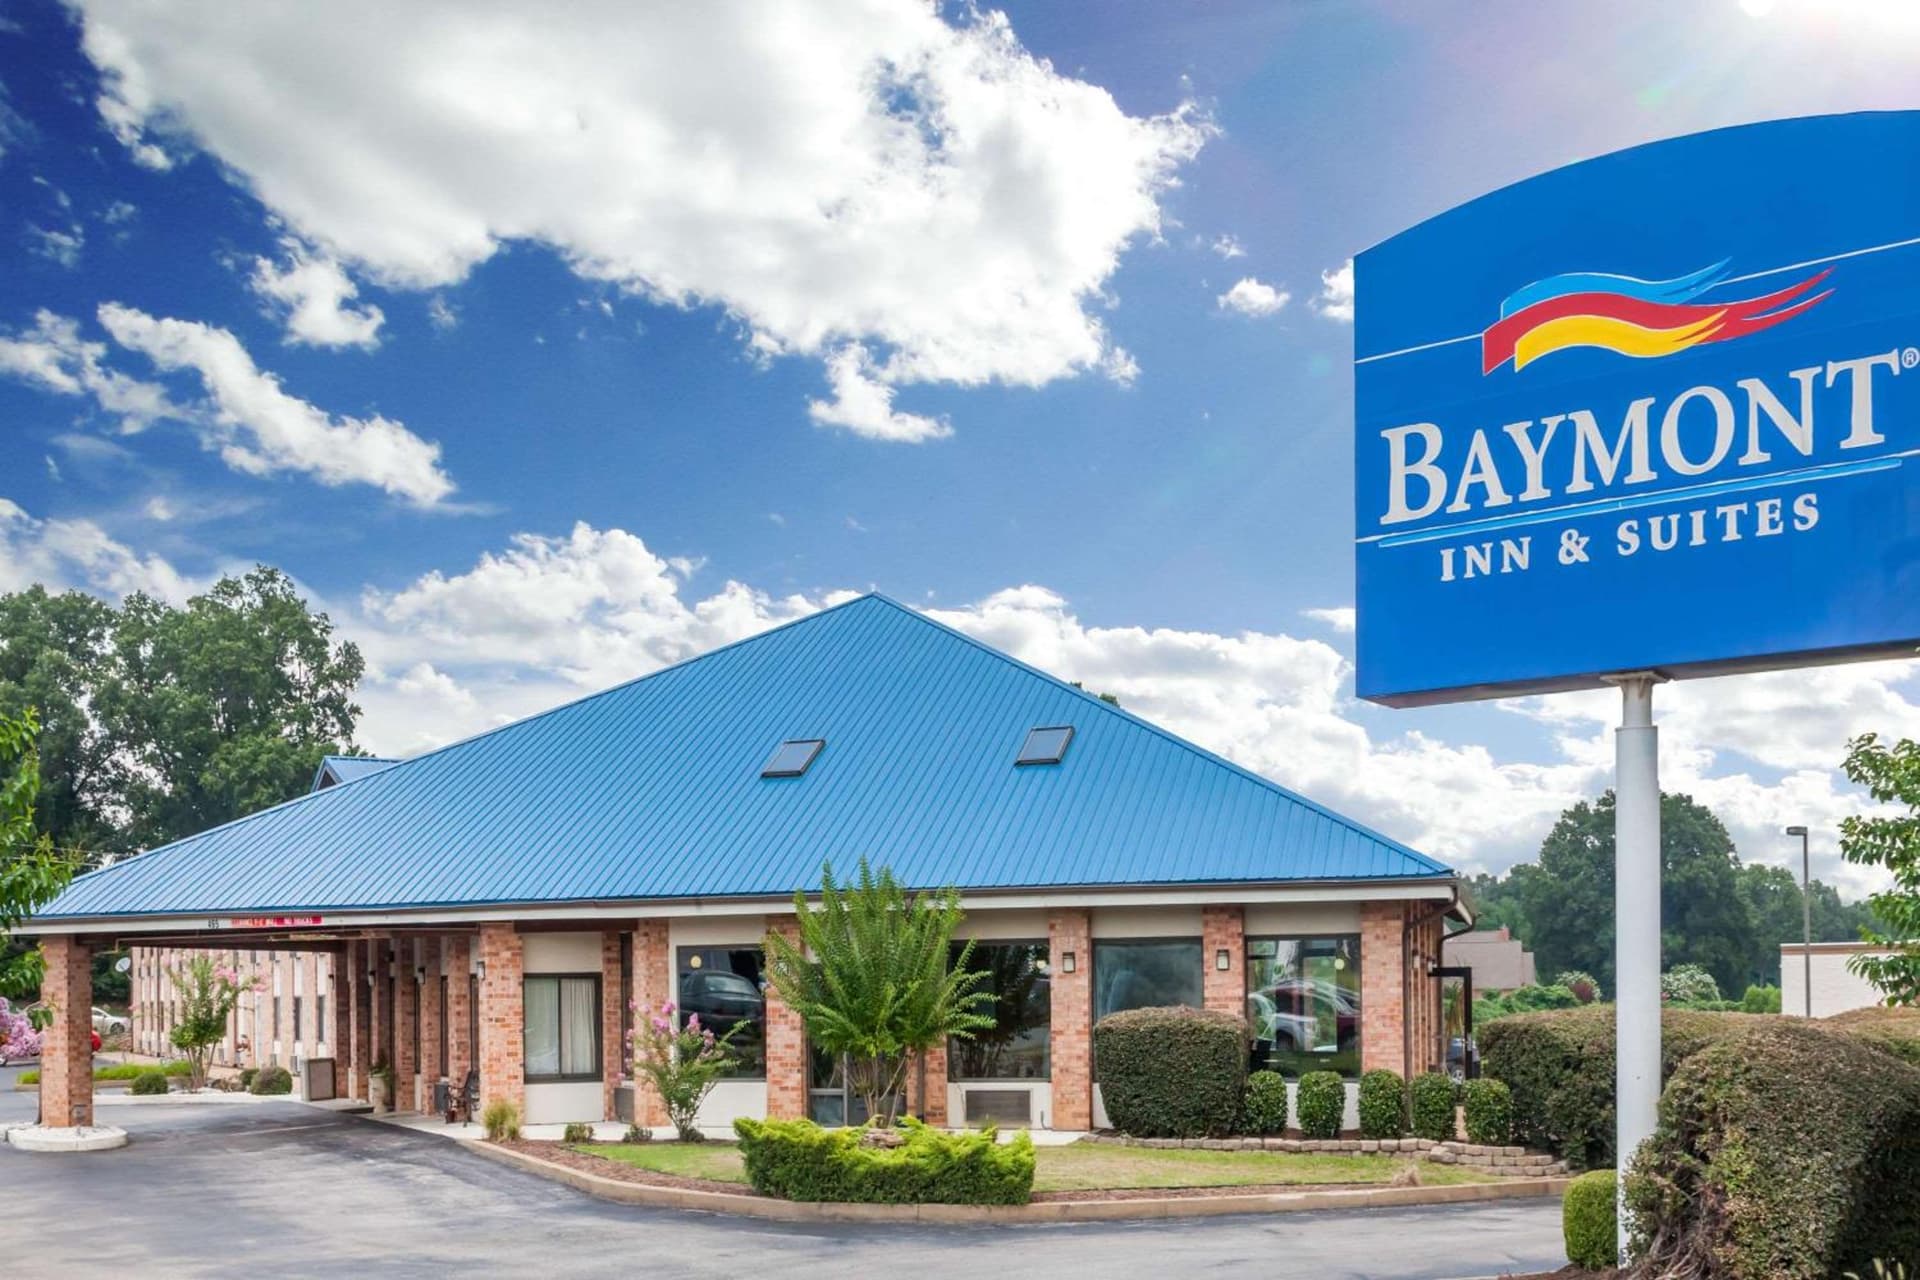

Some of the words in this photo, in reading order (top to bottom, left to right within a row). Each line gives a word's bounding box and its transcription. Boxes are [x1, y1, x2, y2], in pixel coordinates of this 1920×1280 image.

[1380, 348, 1900, 525] BAYMONT
[1440, 536, 1531, 581] INN
[1558, 529, 1590, 566] &
[1616, 493, 1820, 556] SUITES
